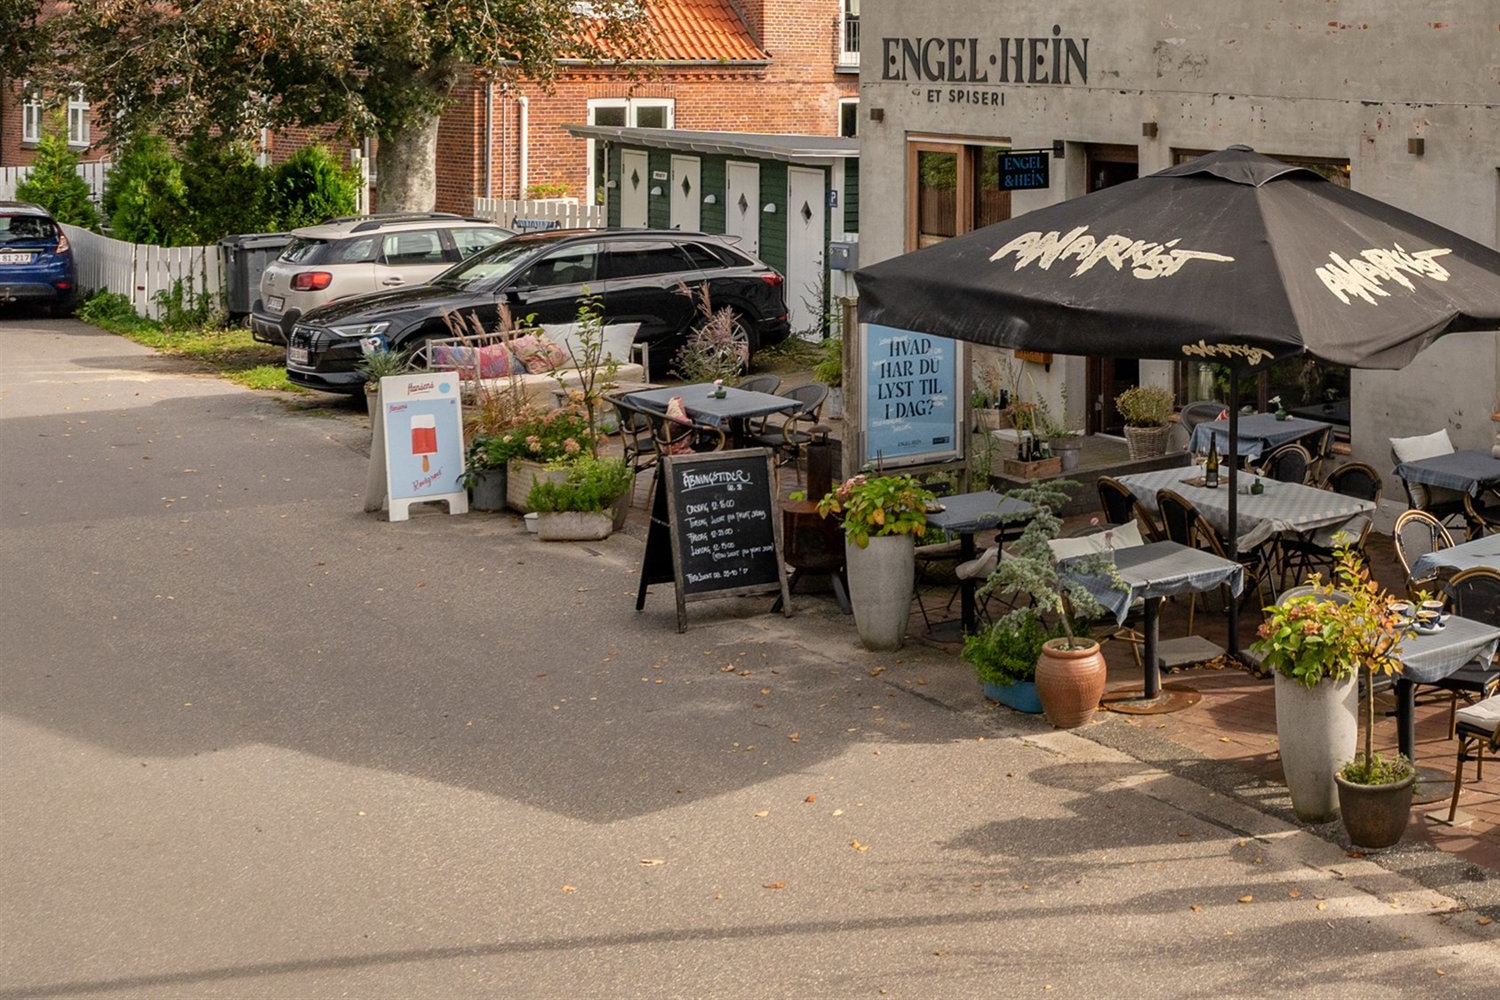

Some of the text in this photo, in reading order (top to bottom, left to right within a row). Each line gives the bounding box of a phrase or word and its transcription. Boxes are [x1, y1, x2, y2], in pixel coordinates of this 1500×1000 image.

[927, 89, 1005, 106] ET SPISERI
[1004, 156, 1044, 171] ENGEL
[889, 338, 932, 357] HVAD
[880, 358, 940, 379] HAR DU
[877, 378, 943, 400] LYST TIL
[885, 399, 935, 420] I DAG?
